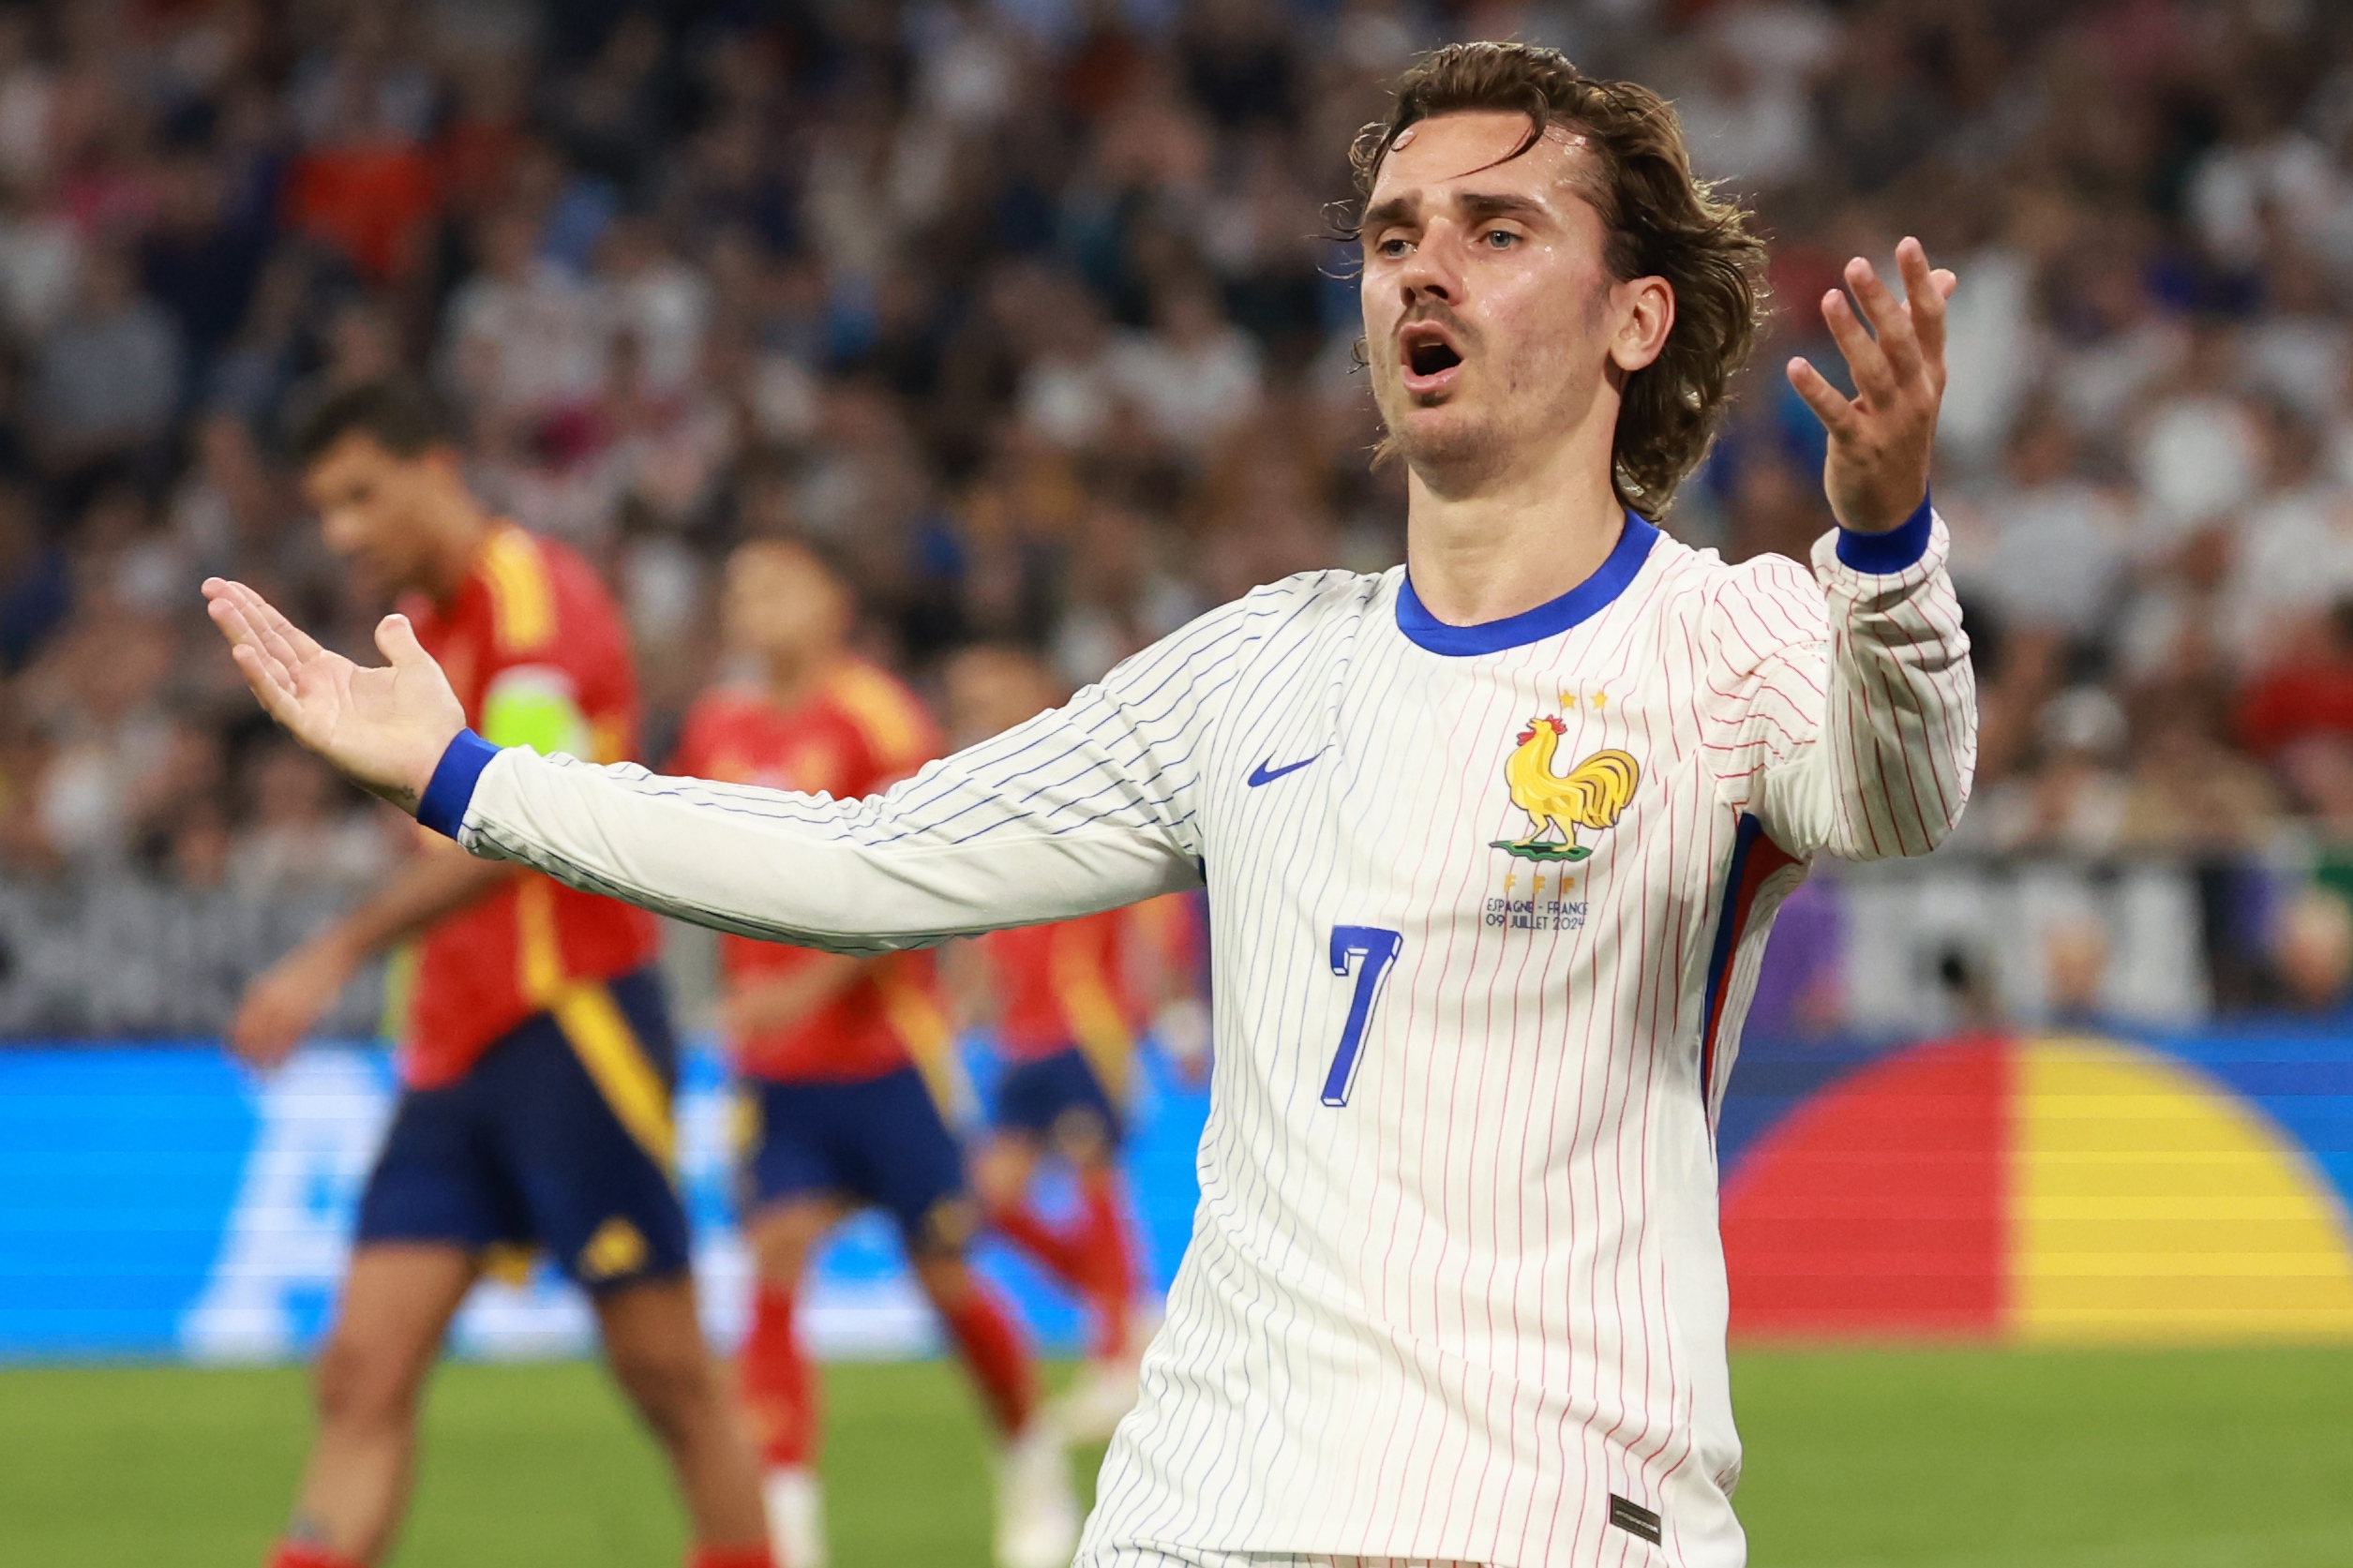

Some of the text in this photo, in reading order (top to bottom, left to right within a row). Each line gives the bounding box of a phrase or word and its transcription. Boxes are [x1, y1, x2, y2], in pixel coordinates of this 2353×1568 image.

[1487, 898, 1535, 913] ESPAGNE
[1547, 902, 1589, 916] FRANCE
[1486, 914, 1584, 931] 09 JUILLET 2024
[1321, 925, 1403, 1108] 7
